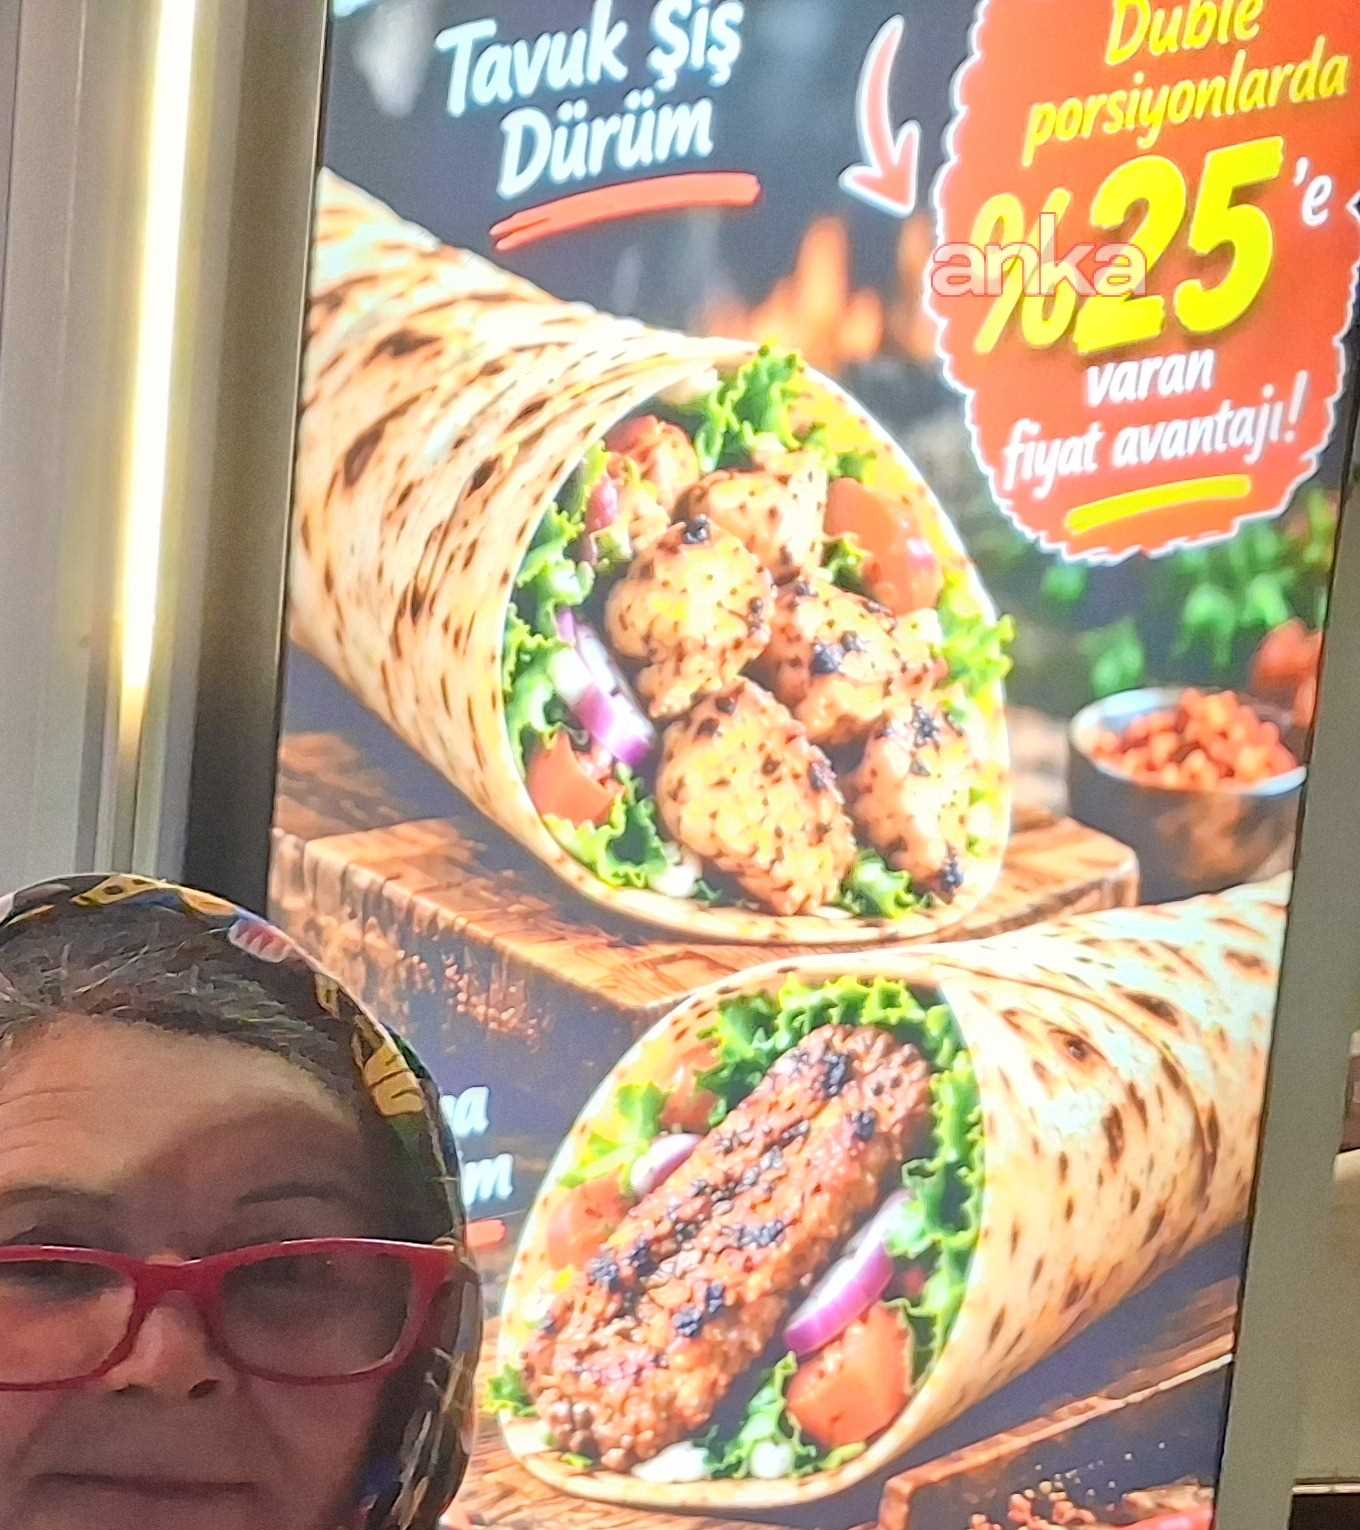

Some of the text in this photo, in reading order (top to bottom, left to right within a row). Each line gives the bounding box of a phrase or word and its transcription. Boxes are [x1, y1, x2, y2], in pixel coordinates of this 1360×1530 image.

[433, 0, 745, 118] Tavuk Şiş
[1022, 36, 1351, 168] porsiyonlarda
[496, 89, 715, 199] Dürüm
[1004, 371, 1308, 498] fiyat avantajı!
[1086, 349, 1216, 408] varan
